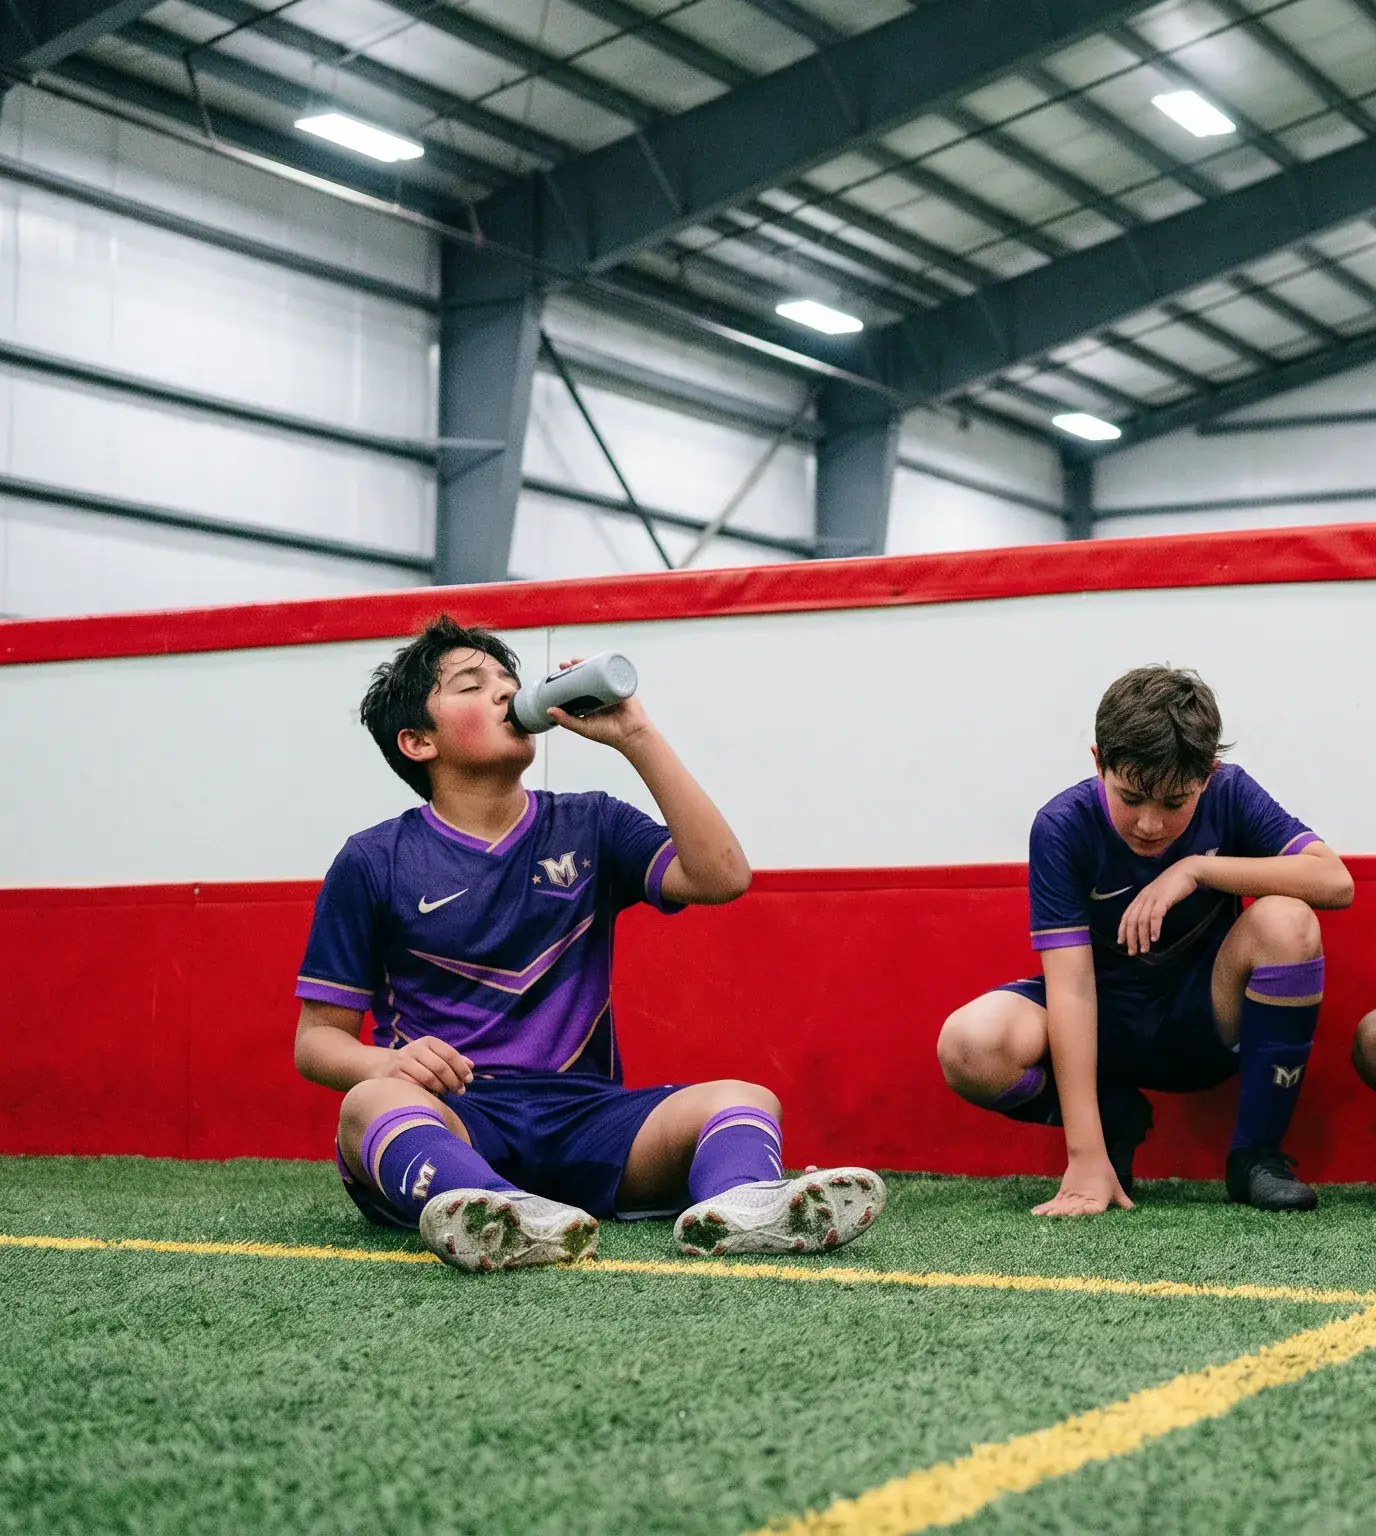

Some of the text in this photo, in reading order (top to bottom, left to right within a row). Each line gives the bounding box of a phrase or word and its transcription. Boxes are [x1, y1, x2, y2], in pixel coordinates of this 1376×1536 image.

[537, 851, 578, 887] M
[1271, 1064, 1304, 1088] M
[412, 1157, 437, 1200] M
